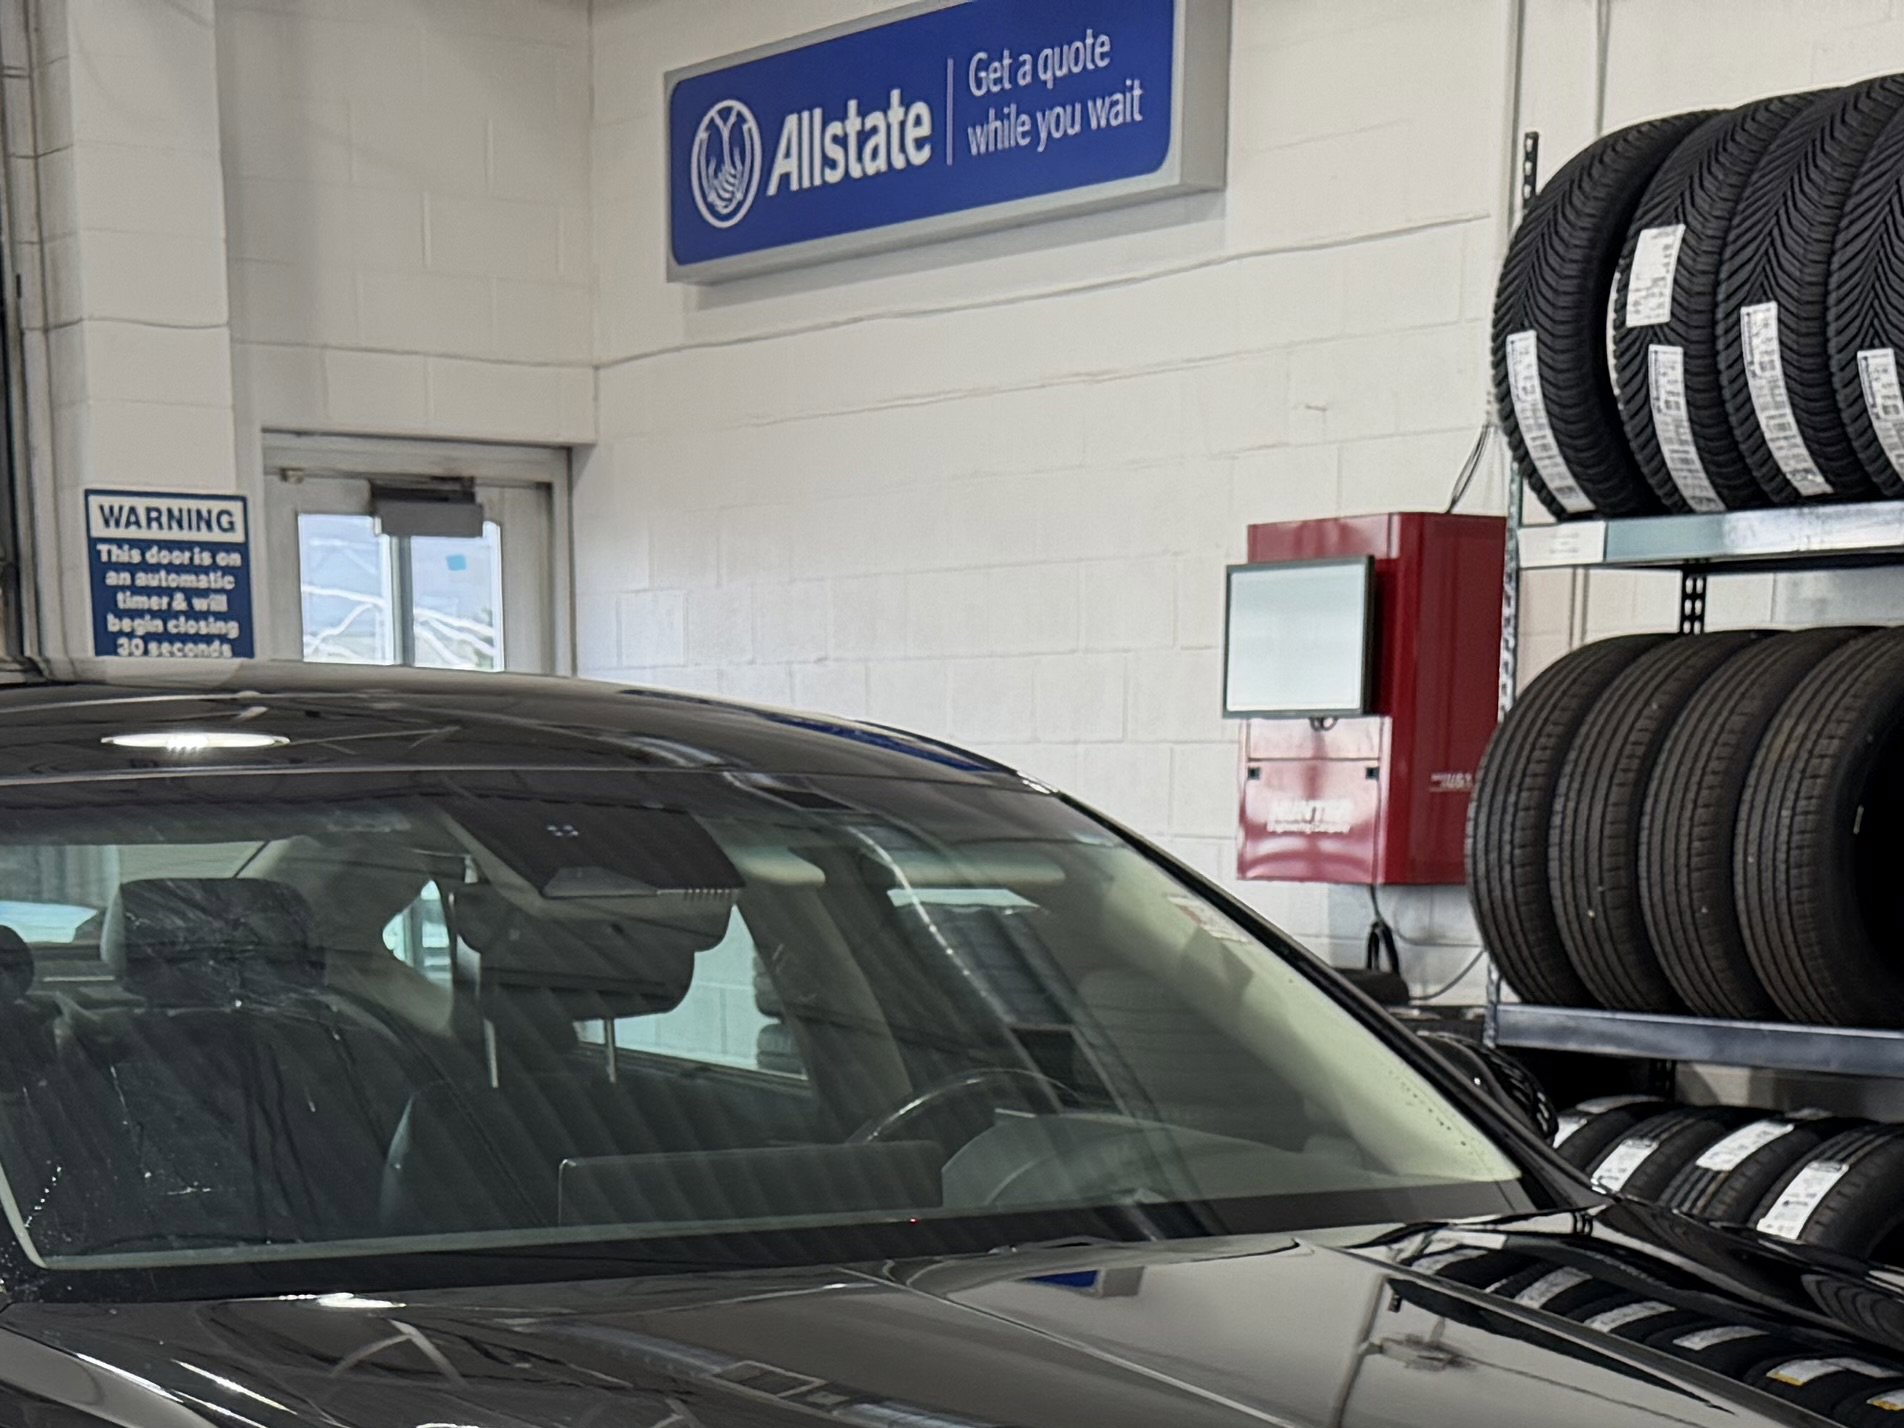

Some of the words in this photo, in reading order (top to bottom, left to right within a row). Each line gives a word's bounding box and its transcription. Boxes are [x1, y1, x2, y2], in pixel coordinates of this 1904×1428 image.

[968, 49, 1012, 97] Get
[1016, 53, 1032, 86] a
[1037, 28, 1111, 89] quote
[967, 102, 1031, 156] while
[1036, 102, 1082, 153] you
[1088, 79, 1144, 131] wait
[765, 87, 933, 197] Allstate
[99, 504, 236, 533] WARNING
[96, 543, 142, 563] This
[145, 545, 191, 565] door
[193, 546, 212, 566] is
[216, 551, 242, 567] on
[105, 570, 132, 586] an
[135, 569, 236, 590] automatic
[116, 590, 170, 611] timer
[172, 592, 189, 611] &
[192, 593, 228, 612] will
[107, 611, 164, 636] begin
[167, 615, 240, 639] closing
[117, 637, 144, 656] 30
[148, 639, 232, 657] seconds
